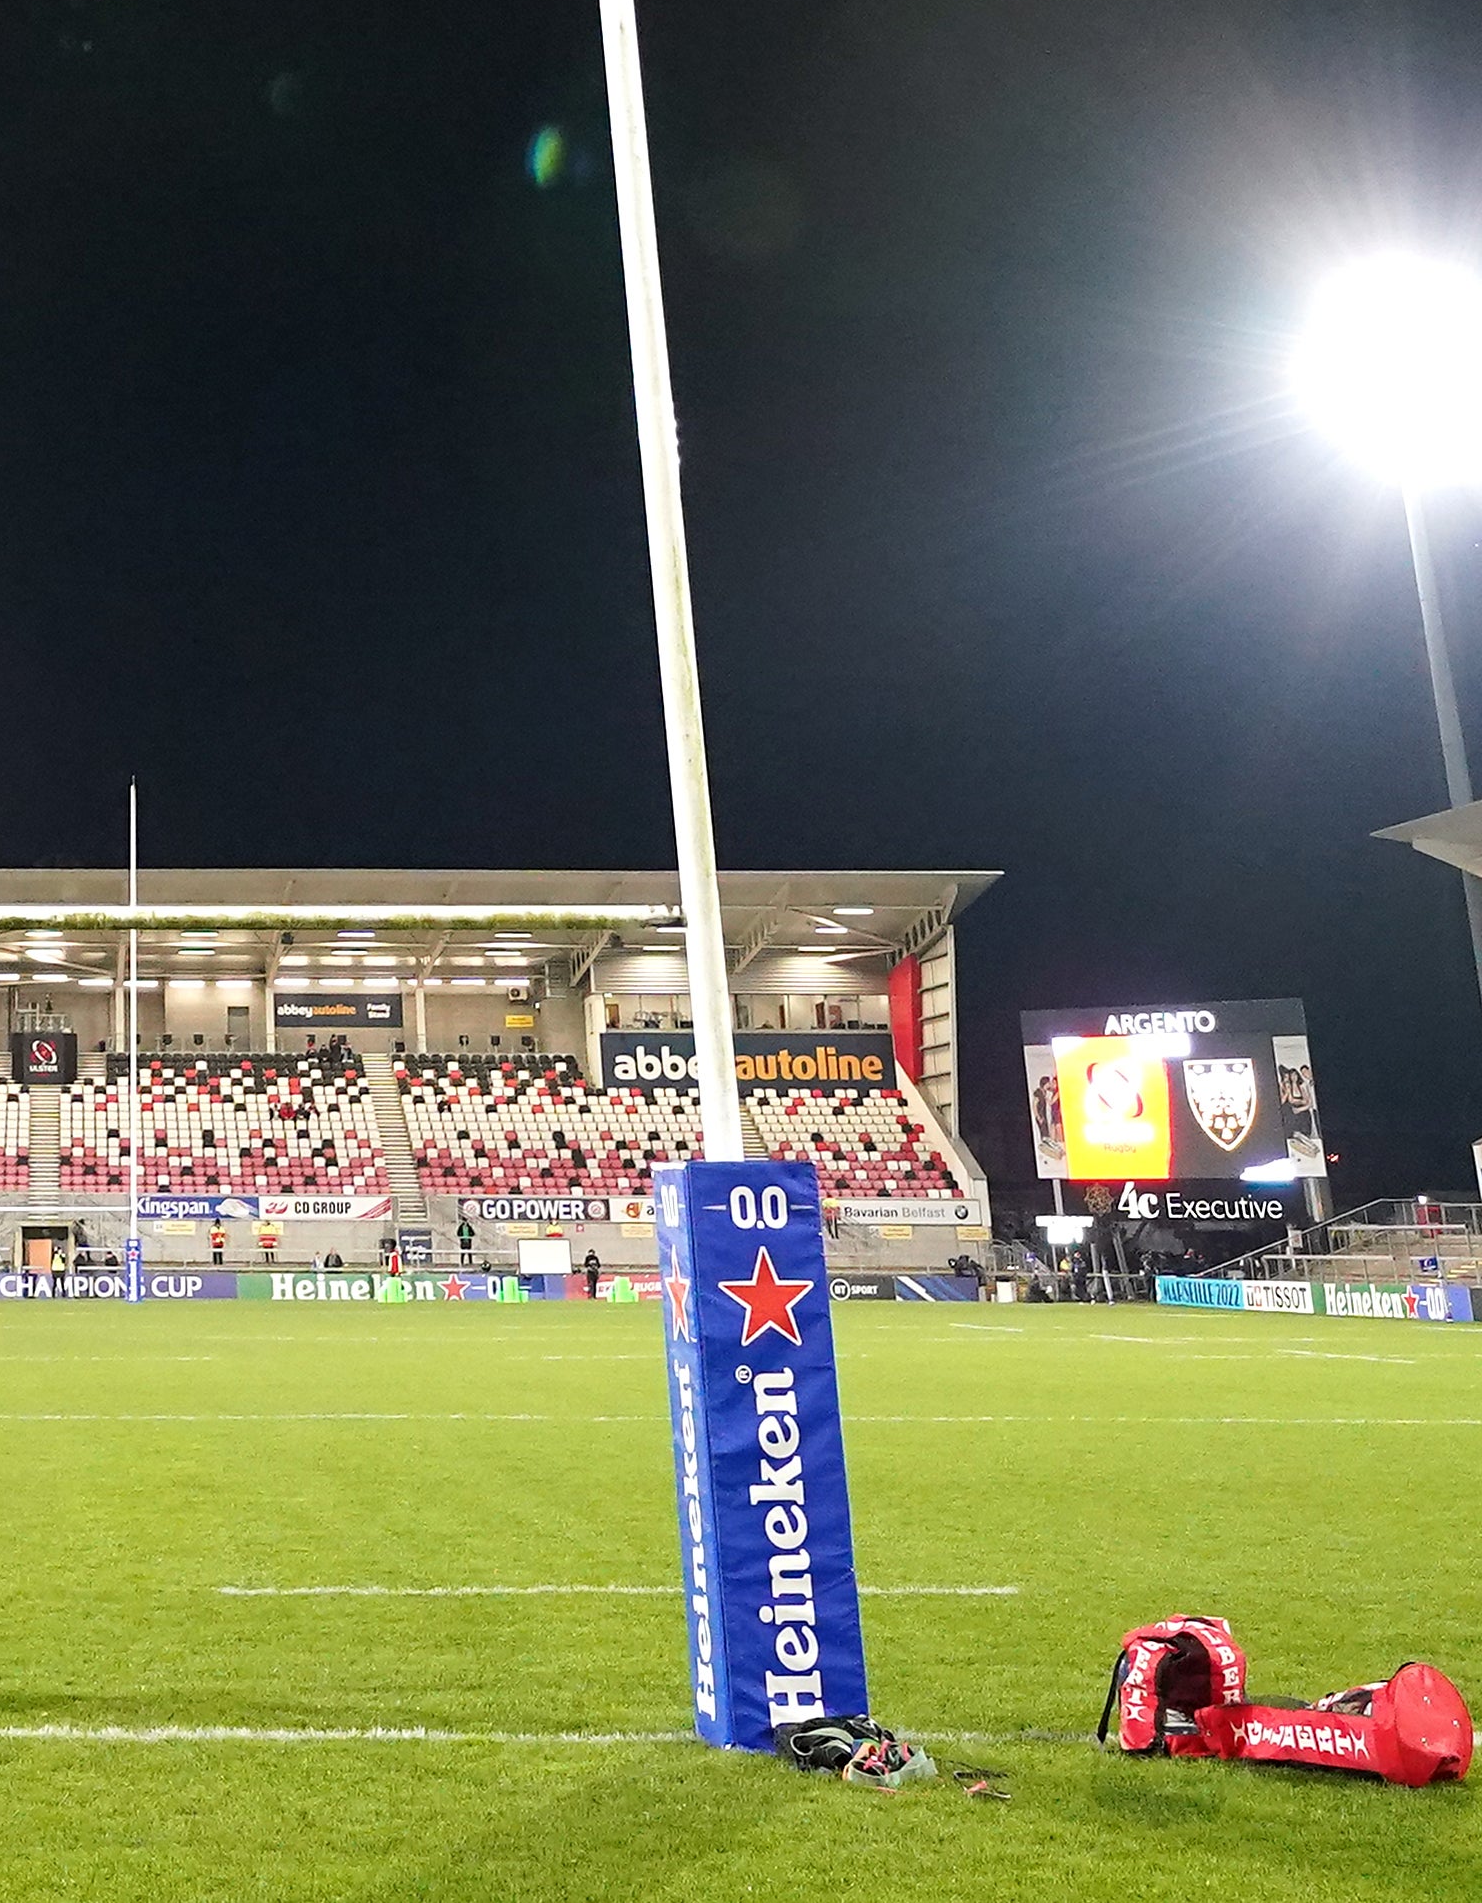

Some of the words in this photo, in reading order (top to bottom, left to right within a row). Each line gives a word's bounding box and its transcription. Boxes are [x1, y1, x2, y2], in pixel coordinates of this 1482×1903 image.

[1104, 1009, 1216, 1036] ARGENTO
[1104, 1142, 1137, 1154] Rugby
[137, 1198, 209, 1220] Kingspan
[312, 1201, 352, 1215] GROUP
[482, 1199, 511, 1219] GO
[513, 1198, 585, 1219] POWER
[729, 1184, 789, 1230] 0.0
[844, 1206, 899, 1219] Bavarian
[901, 1206, 947, 1219] Belfast
[1117, 1181, 1160, 1219] 4c
[1165, 1194, 1283, 1219] Executive
[151, 1275, 203, 1298] CUP
[851, 1284, 878, 1296] SPORT
[1215, 1281, 1241, 1306] 2022
[1263, 1284, 1307, 1309] TISSOT
[1323, 1283, 1405, 1318] Heineken
[677, 1361, 717, 1722] Heineken
[750, 1365, 826, 1729] Heineken
